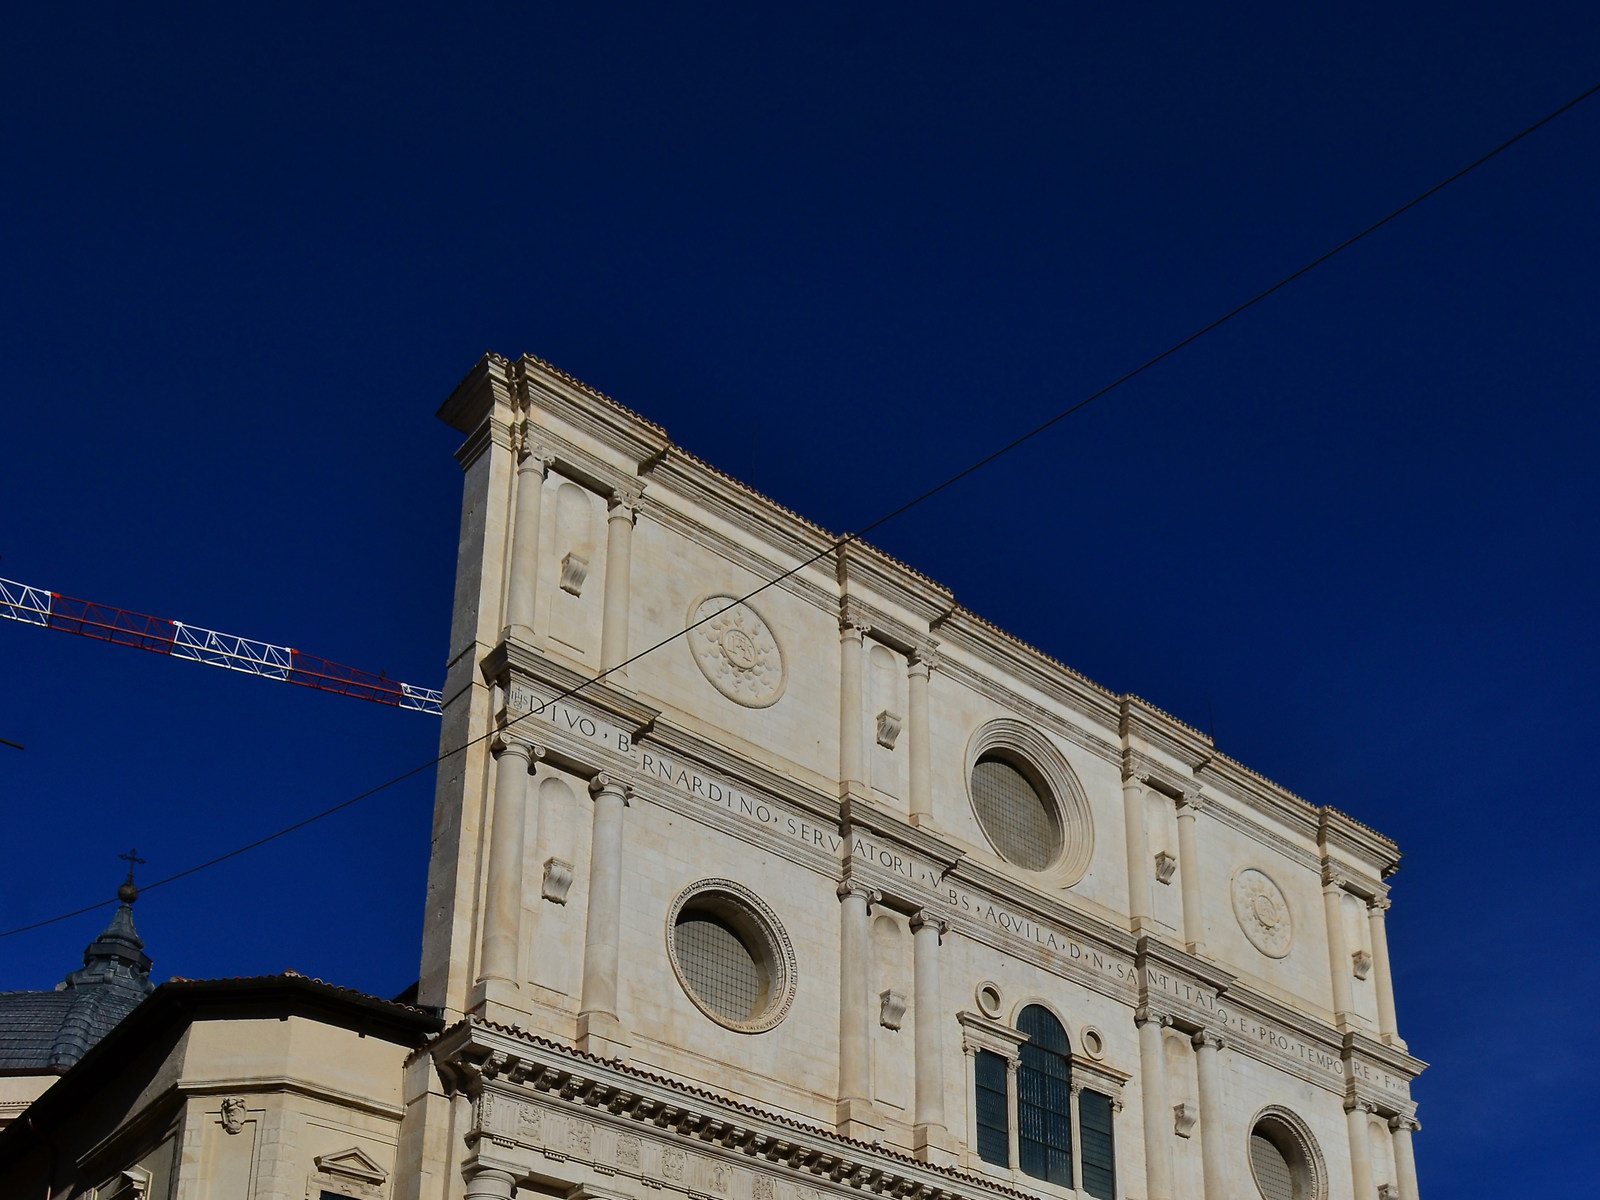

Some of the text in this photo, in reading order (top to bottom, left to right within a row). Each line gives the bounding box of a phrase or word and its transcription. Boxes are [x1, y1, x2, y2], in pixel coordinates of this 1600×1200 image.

[529, 694, 596, 737] DIVO
[787, 818, 913, 878] SERVATORI
[929, 871, 970, 911] VBS
[985, 906, 1058, 950] AQVILA
[1070, 943, 1082, 959] D
[1093, 953, 1103, 969] N
[1259, 1026, 1288, 1050] PRO
[1298, 1043, 1370, 1080] TEMPORE
